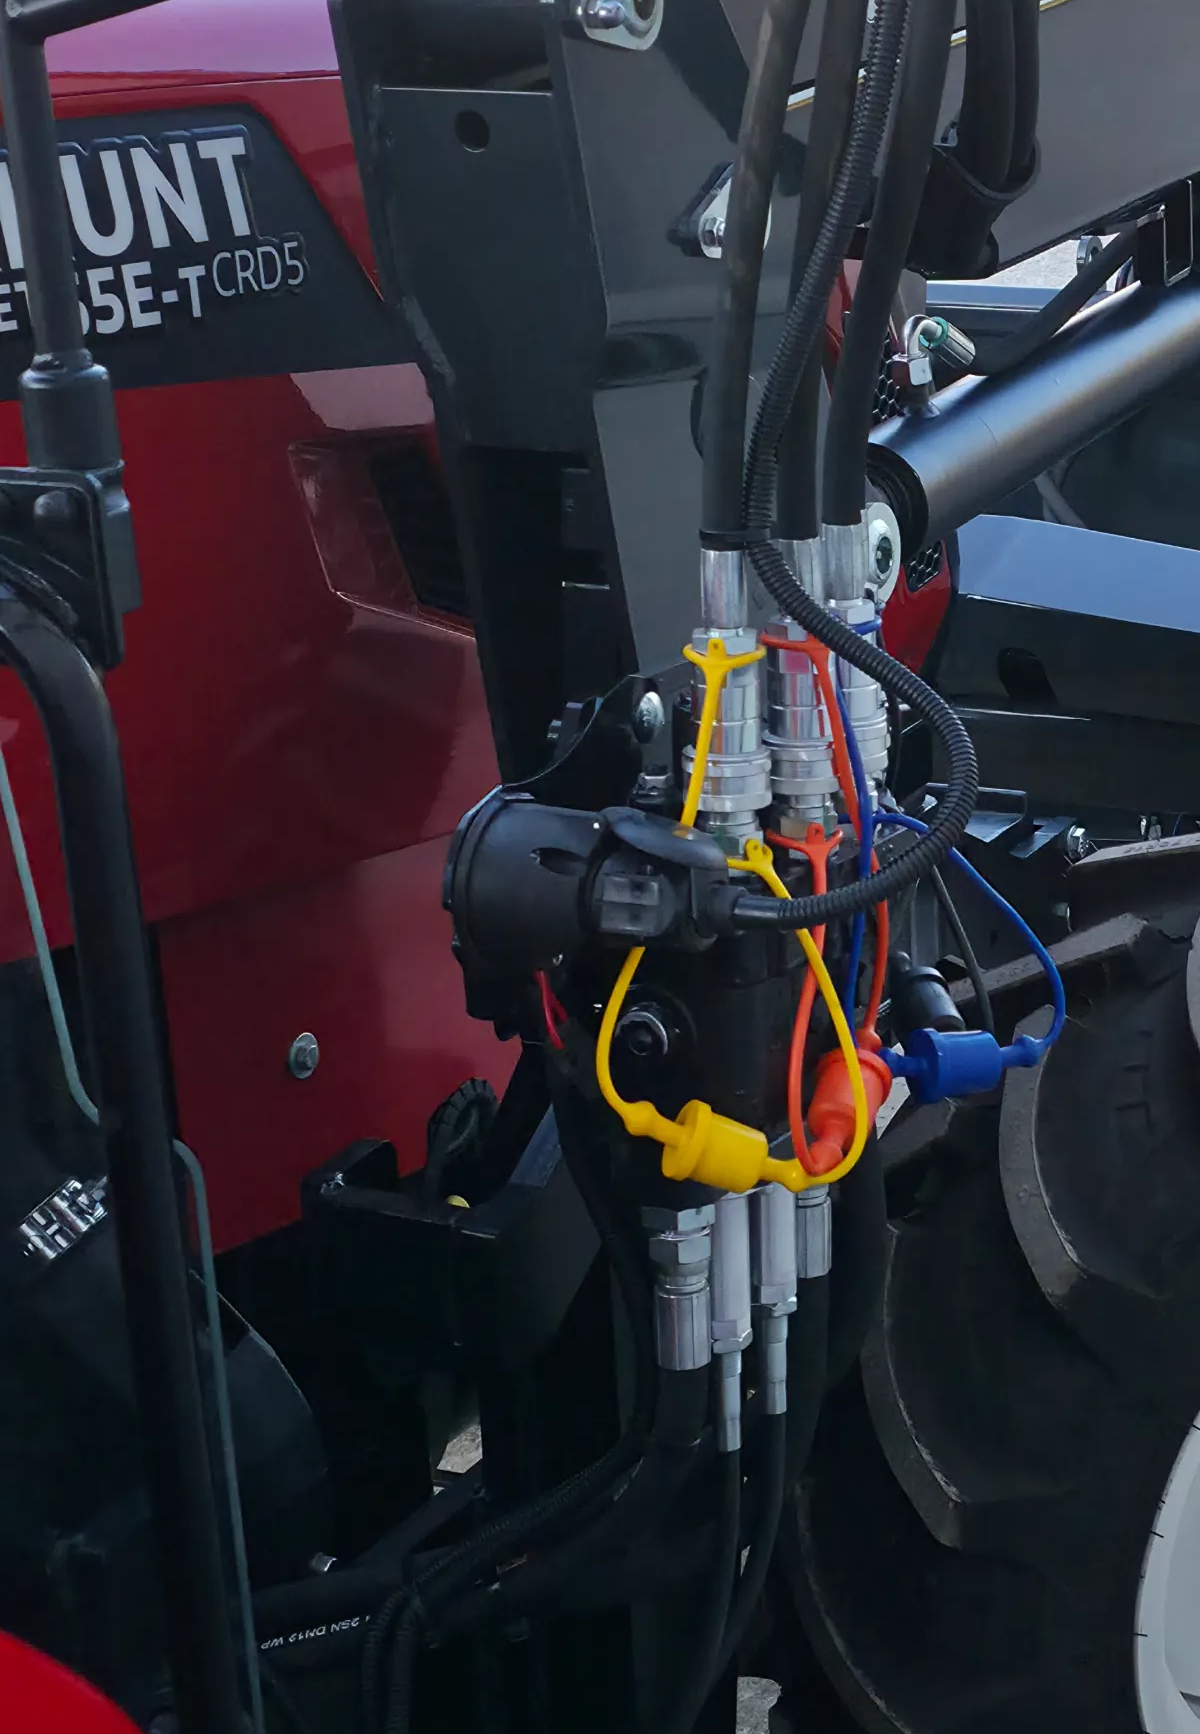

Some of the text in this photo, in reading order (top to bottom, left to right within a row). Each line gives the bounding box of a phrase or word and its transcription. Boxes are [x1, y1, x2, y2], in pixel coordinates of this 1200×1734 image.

[213, 241, 305, 297] CRD5
[330, 1617, 361, 1633] 2SN
[260, 1636, 285, 1650] WP
